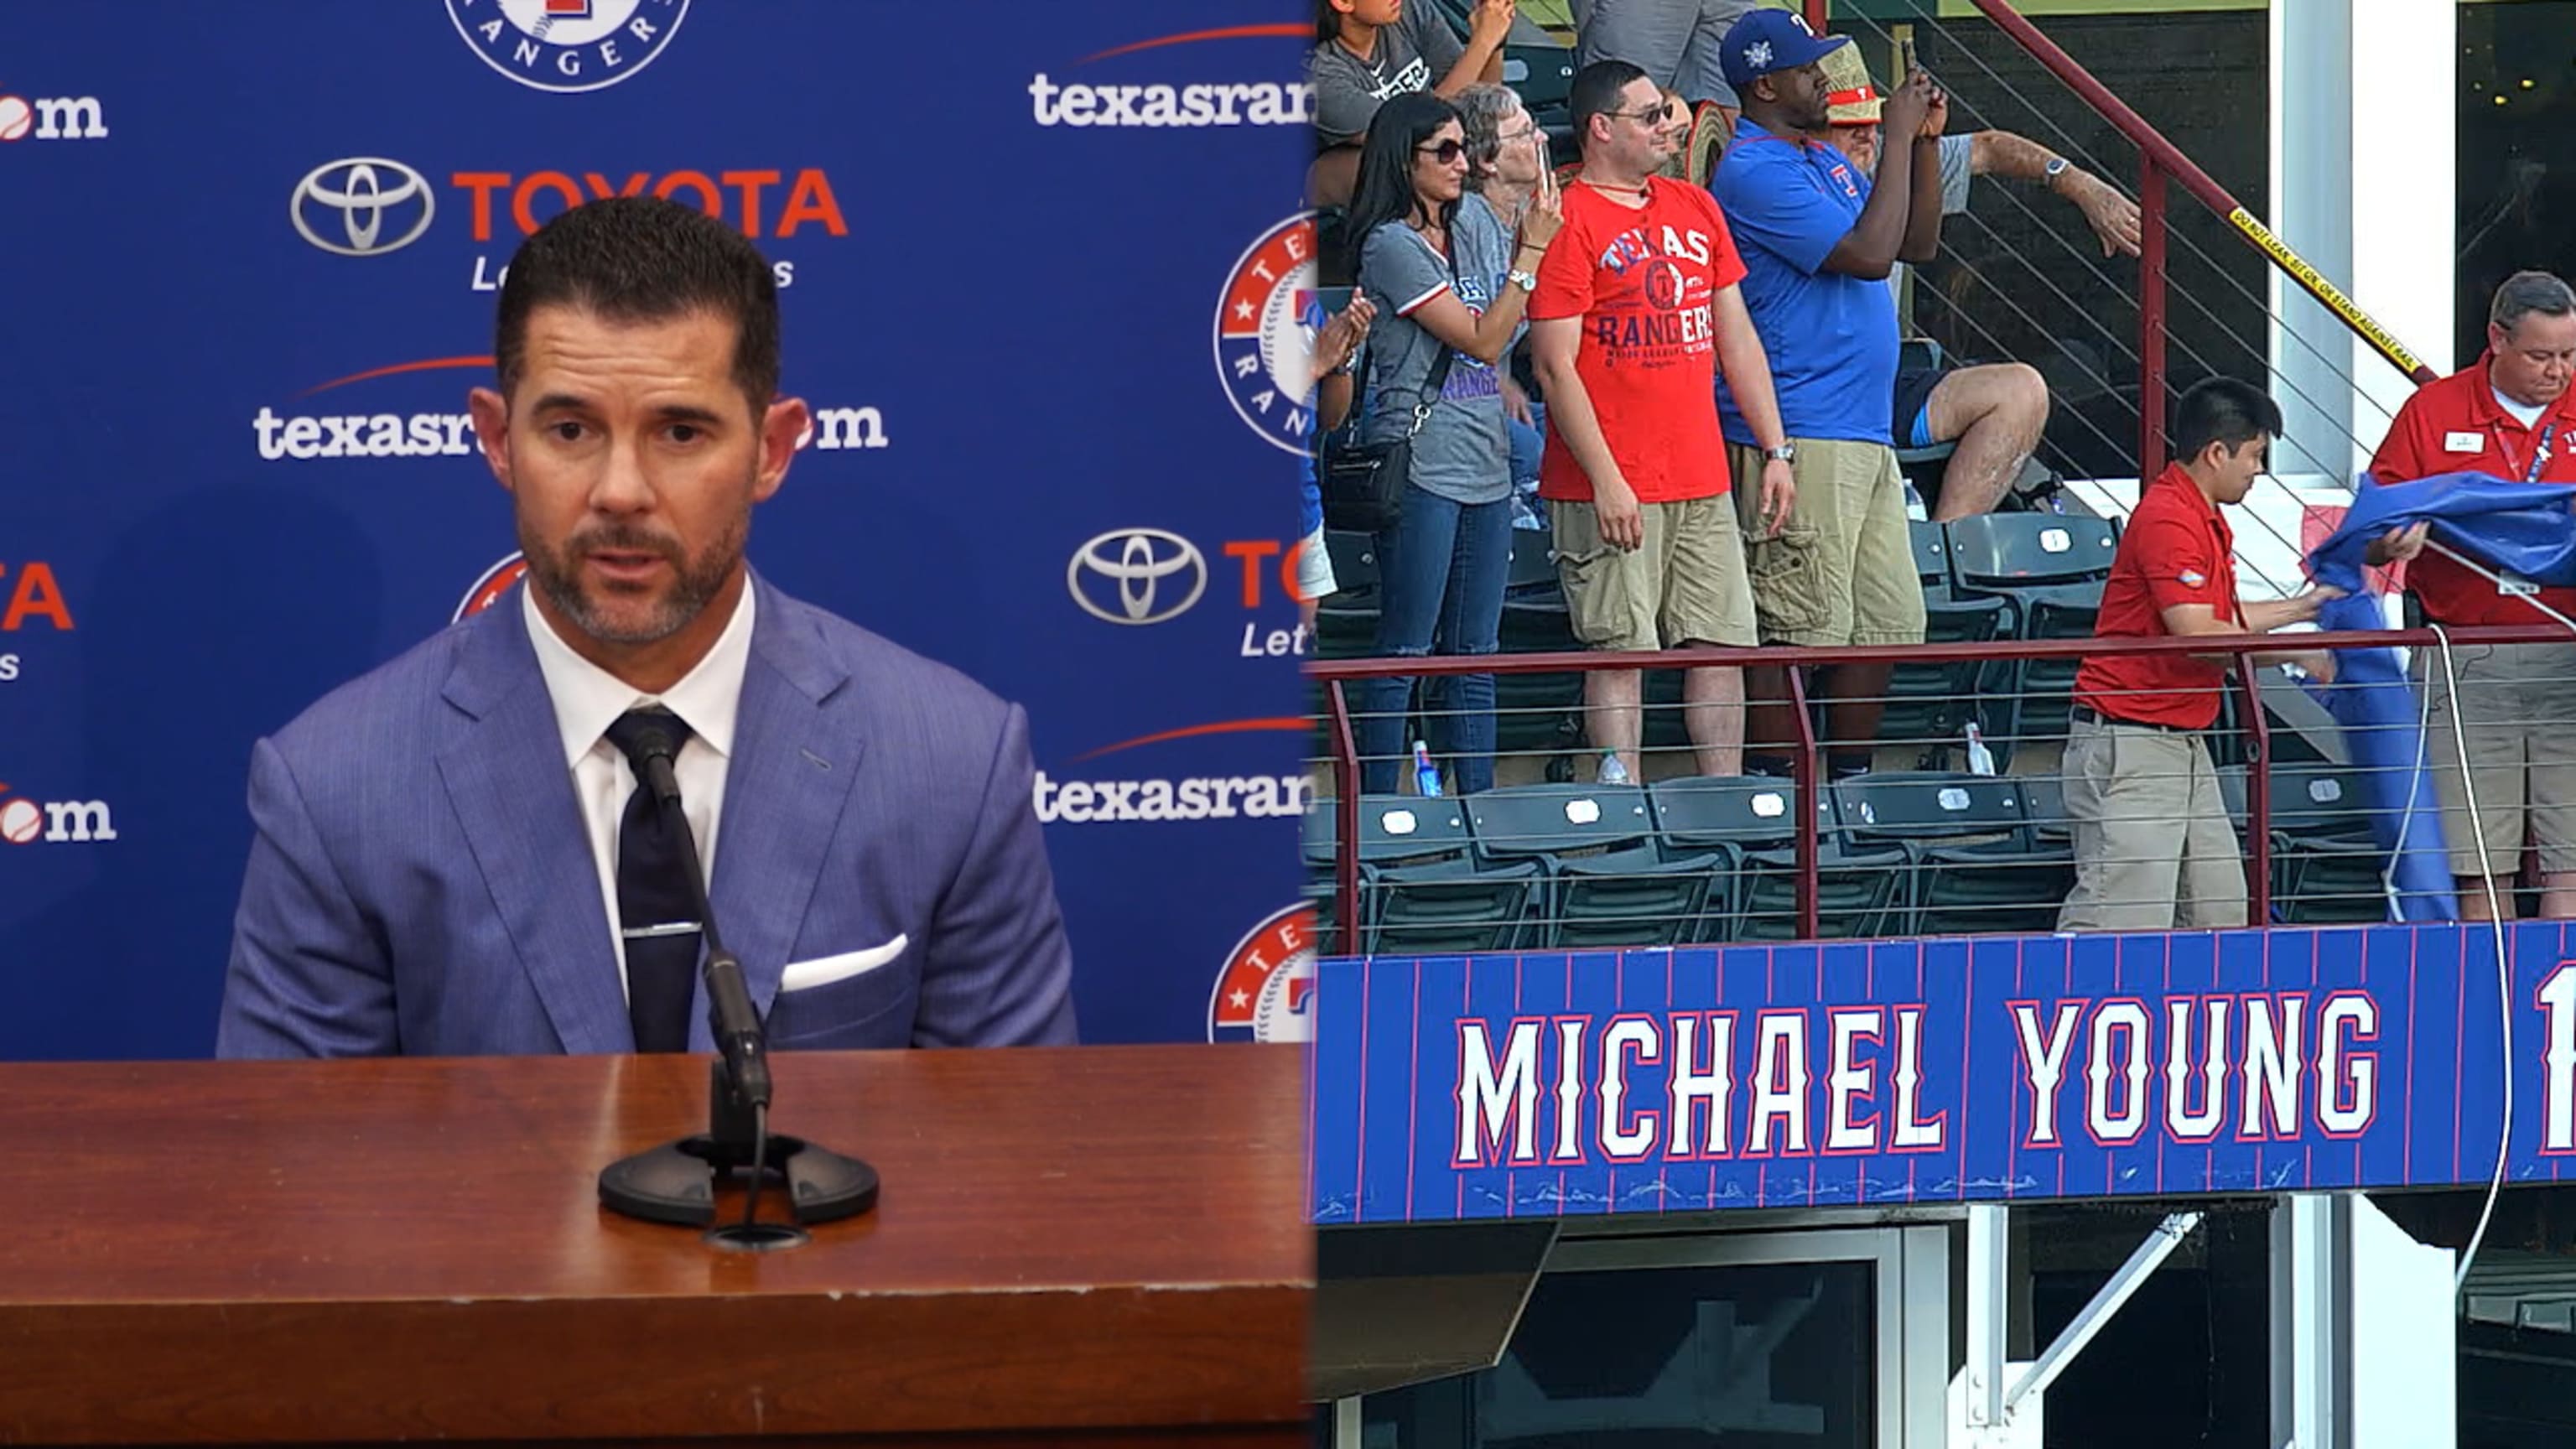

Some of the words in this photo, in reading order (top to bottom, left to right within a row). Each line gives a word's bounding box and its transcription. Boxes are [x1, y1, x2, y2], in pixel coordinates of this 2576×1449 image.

[1598, 224, 1710, 277] TEXAS
[1451, 1004, 1947, 1169] MICHAEL
[2006, 989, 2380, 1149] YOUNG
